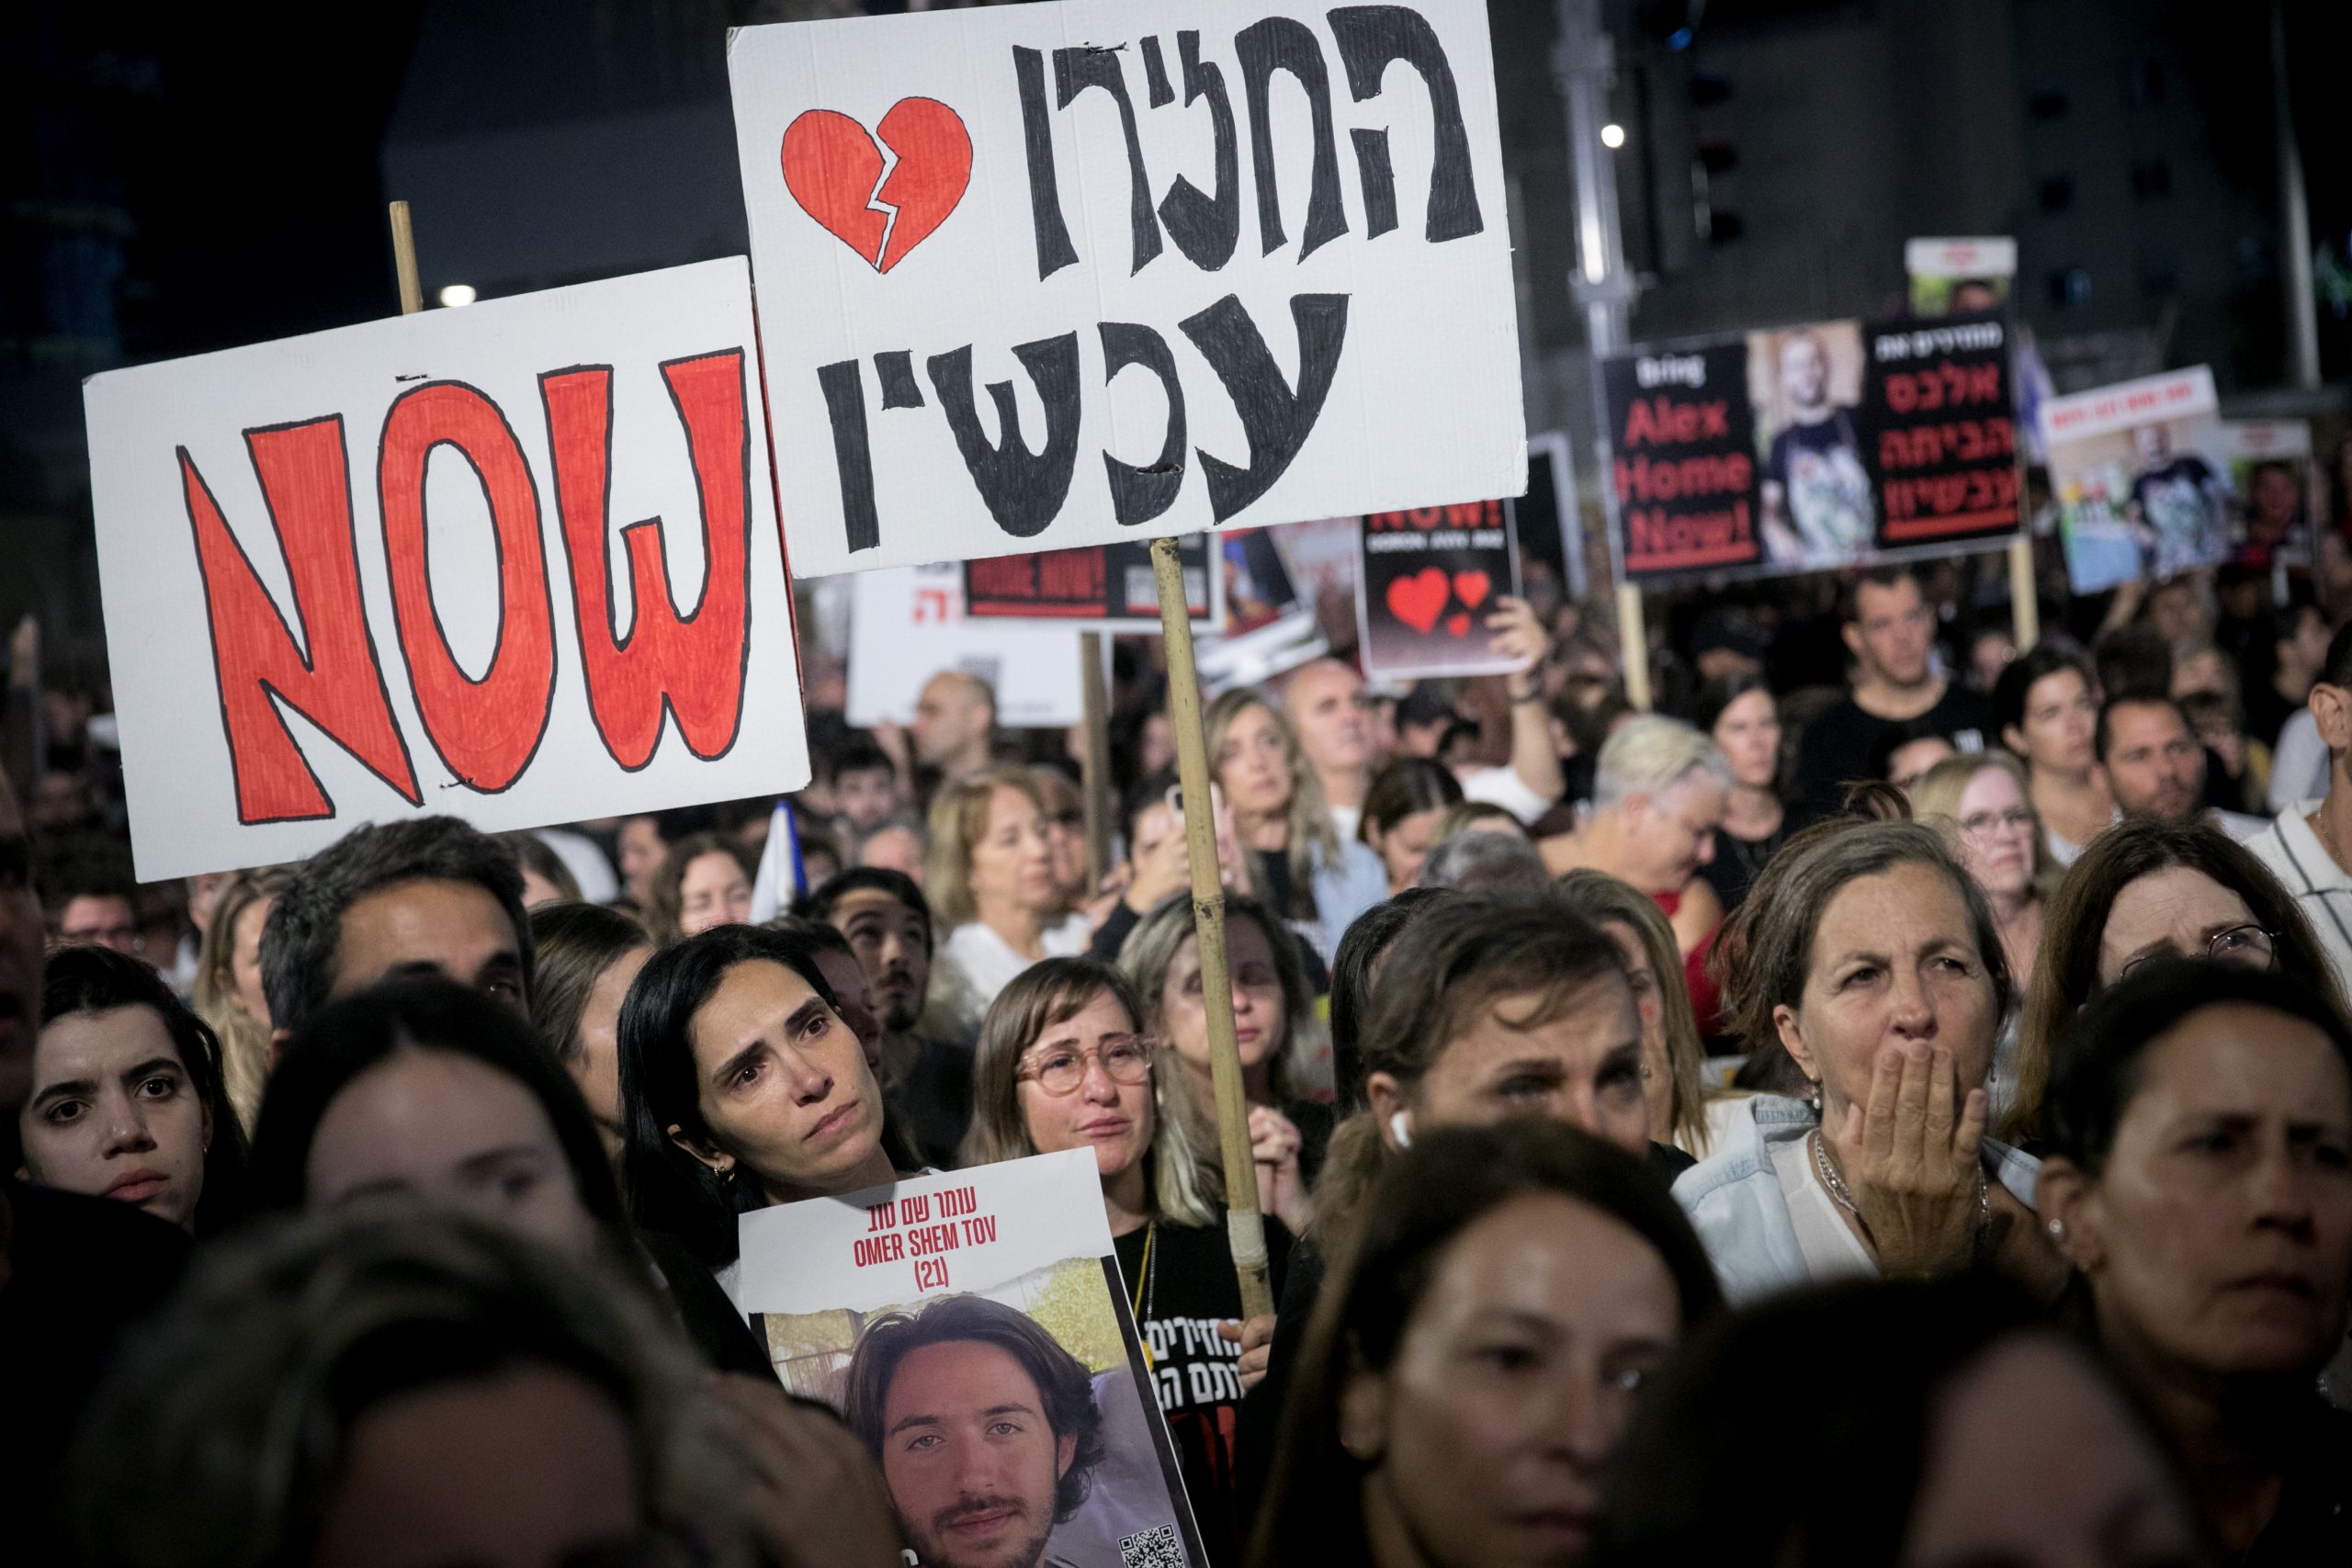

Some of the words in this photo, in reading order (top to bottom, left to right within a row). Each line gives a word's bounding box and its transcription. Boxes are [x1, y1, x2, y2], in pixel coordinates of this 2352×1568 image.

[1885, 362, 1999, 412] אלכס
[816, 293, 1351, 553] עכשיו
[1625, 395, 1727, 446] Alex
[1880, 417, 2013, 470] הביתה
[1614, 453, 1751, 505] Home
[1629, 500, 1750, 553] Now!
[175, 346, 752, 826] NOW
[866, 1201, 896, 1232] טוב
[900, 1195, 930, 1225] שם
[933, 1186, 977, 1219] עומר
[854, 1233, 905, 1268] OMER
[908, 1222, 959, 1257] SHEM
[961, 1214, 997, 1247] TOV
[913, 1256, 949, 1292] (21)
[1144, 1316, 1242, 1361] חזירים
